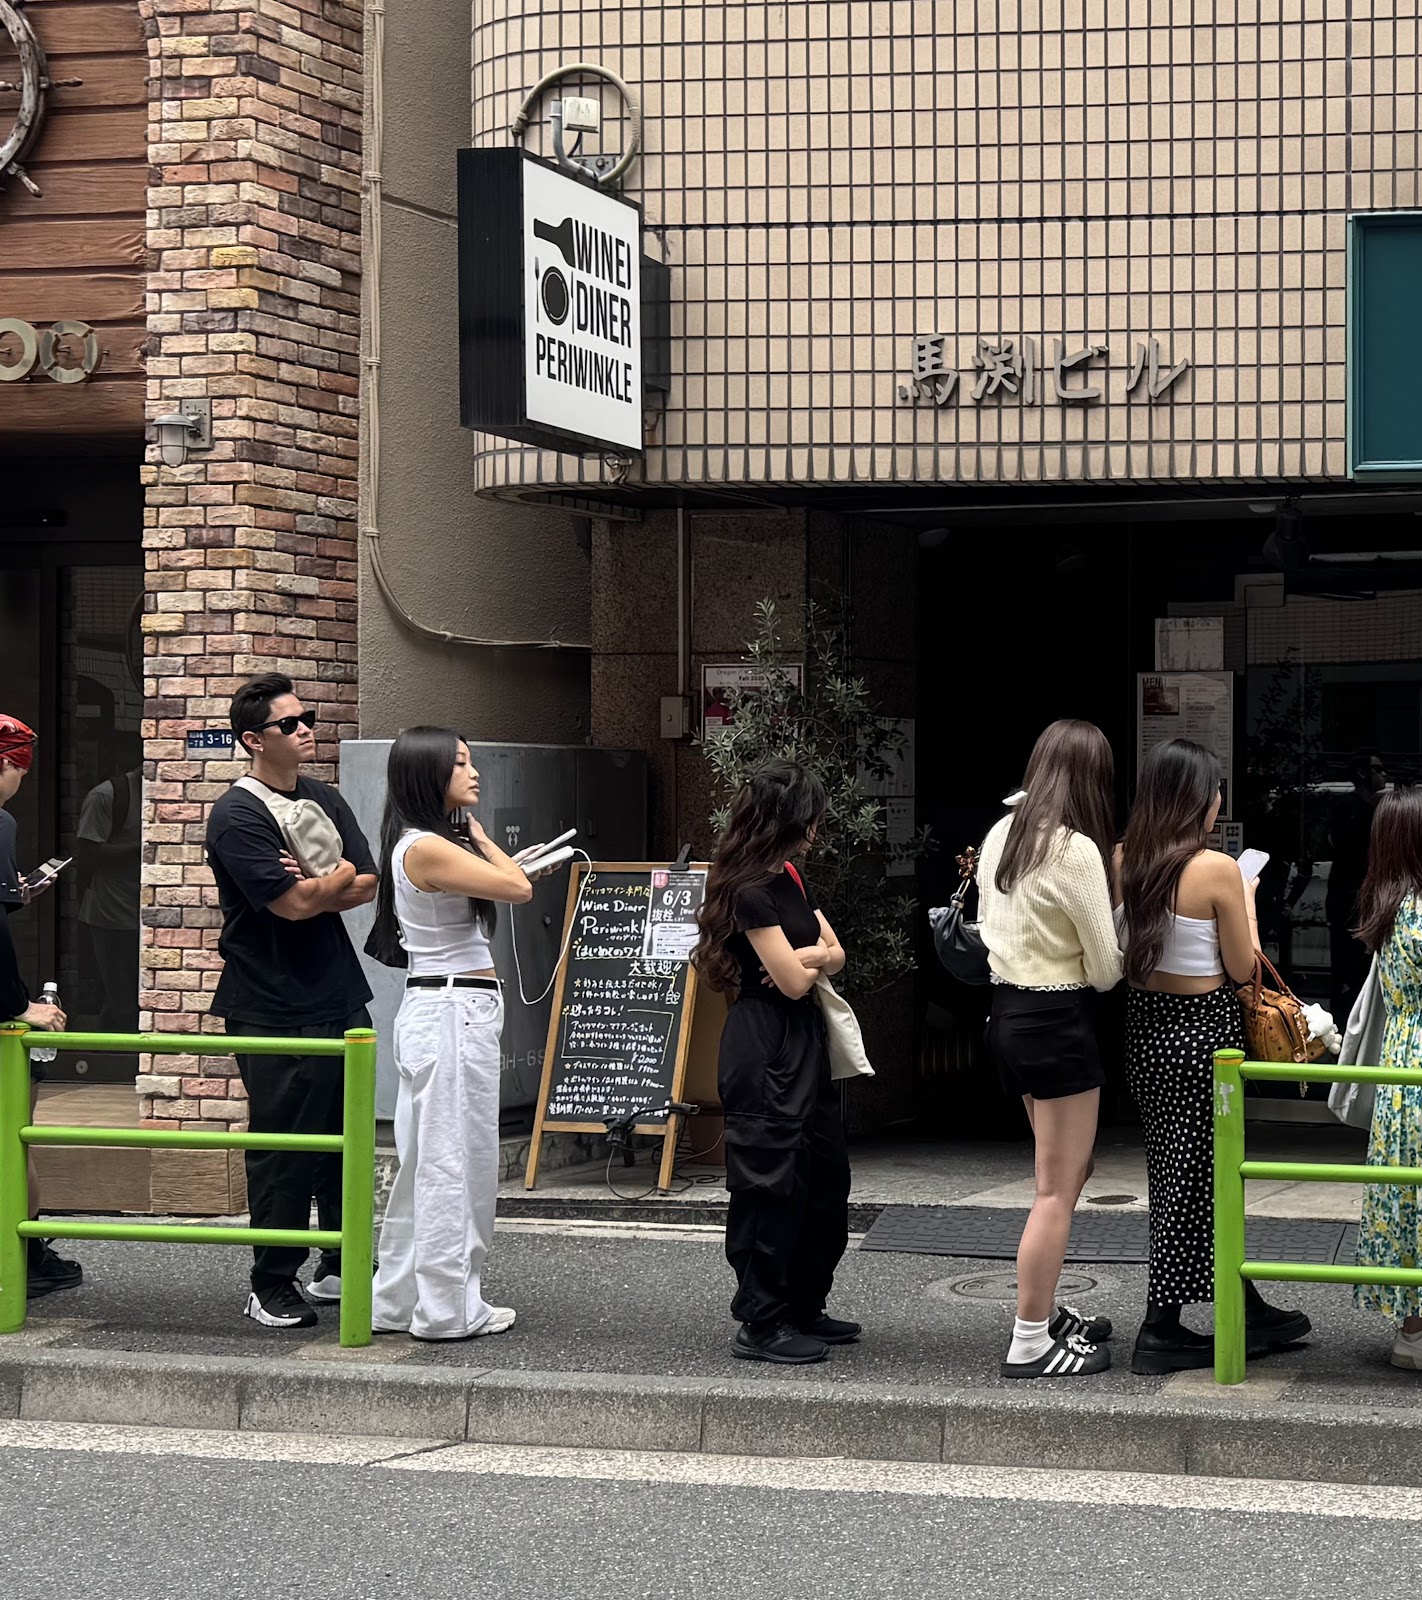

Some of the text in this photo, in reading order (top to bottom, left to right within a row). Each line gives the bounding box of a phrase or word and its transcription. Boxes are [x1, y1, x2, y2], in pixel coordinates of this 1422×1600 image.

[576, 280, 631, 348] DINER
[536, 333, 632, 403] PERIWINKLE
[207, 734, 232, 744] 3-16
[581, 900, 647, 913] Wine Diner
[662, 889, 692, 909] 6/3
[580, 915, 645, 936] Periwinkl
